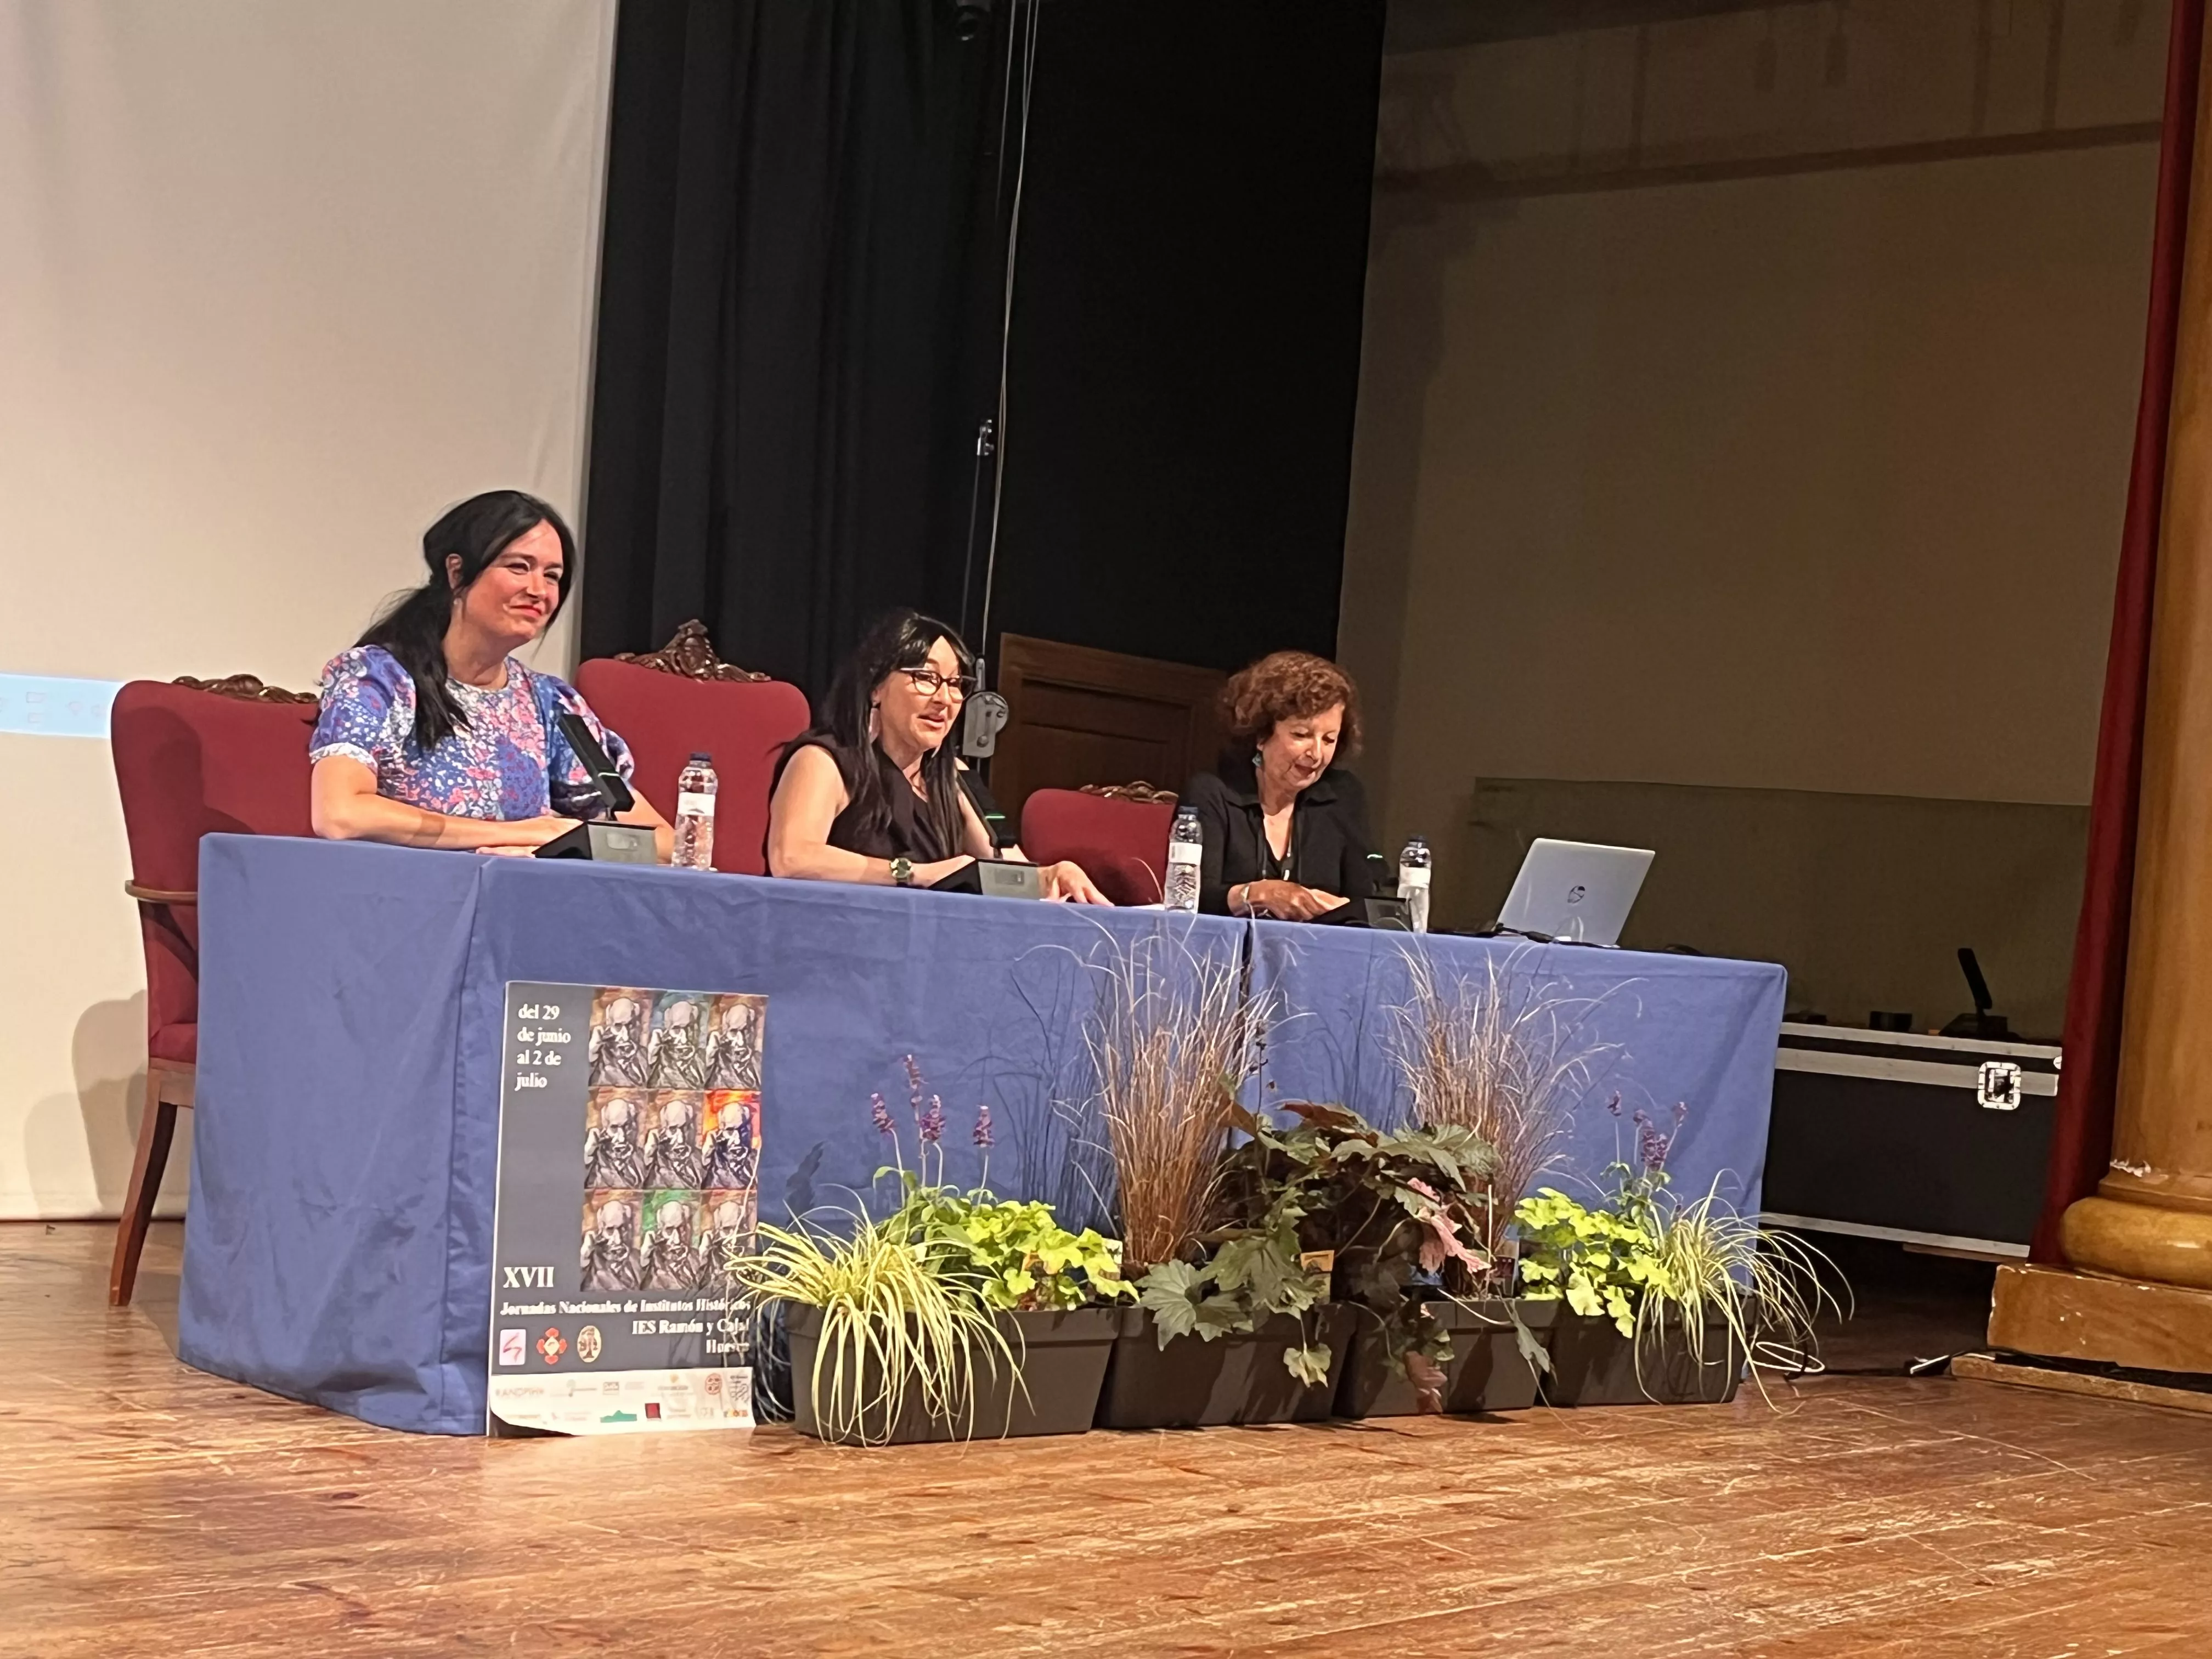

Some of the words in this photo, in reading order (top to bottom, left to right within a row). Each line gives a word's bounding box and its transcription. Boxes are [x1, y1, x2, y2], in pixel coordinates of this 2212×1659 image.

[518, 1003, 539, 1019] del
[542, 1005, 560, 1020] 29
[517, 1026, 535, 1042] de
[535, 1027, 571, 1046] junio
[517, 1049, 530, 1064] al
[532, 1050, 542, 1065] 2
[545, 1051, 562, 1065] de
[514, 1072, 548, 1091] julio
[503, 1266, 555, 1288] XVII
[500, 1301, 556, 1315] Jornadas
[559, 1300, 622, 1314] Nacionales
[623, 1300, 638, 1313] de
[640, 1299, 693, 1312] Institutos
[696, 1298, 751, 1311] Histórcos
[632, 1320, 656, 1334] IES
[659, 1319, 703, 1334] Ramón
[706, 1322, 714, 1336] y
[716, 1318, 750, 1335] Cajal
